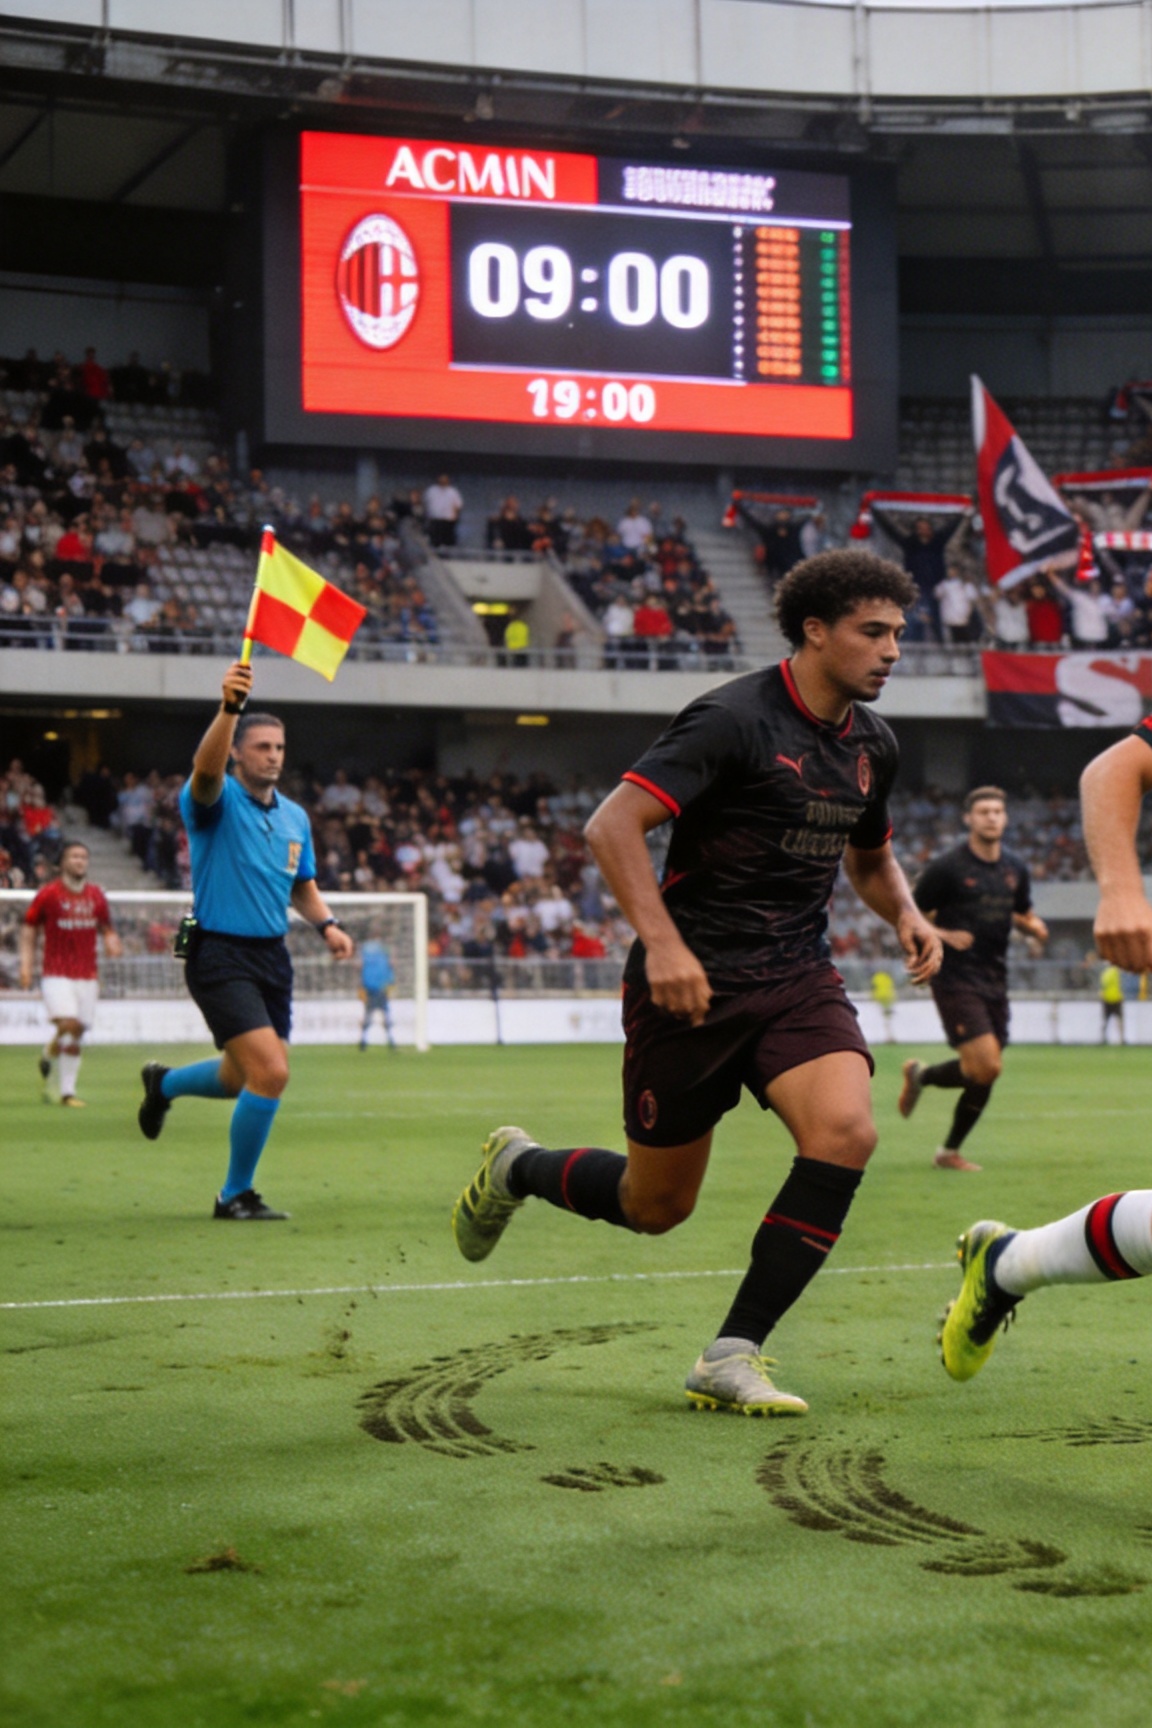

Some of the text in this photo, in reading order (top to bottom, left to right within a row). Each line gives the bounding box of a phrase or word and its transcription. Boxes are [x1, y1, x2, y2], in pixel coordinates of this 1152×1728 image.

[384, 145, 556, 200] ACMIN
[468, 241, 710, 329] 09:00
[526, 378, 656, 423] 19:00
